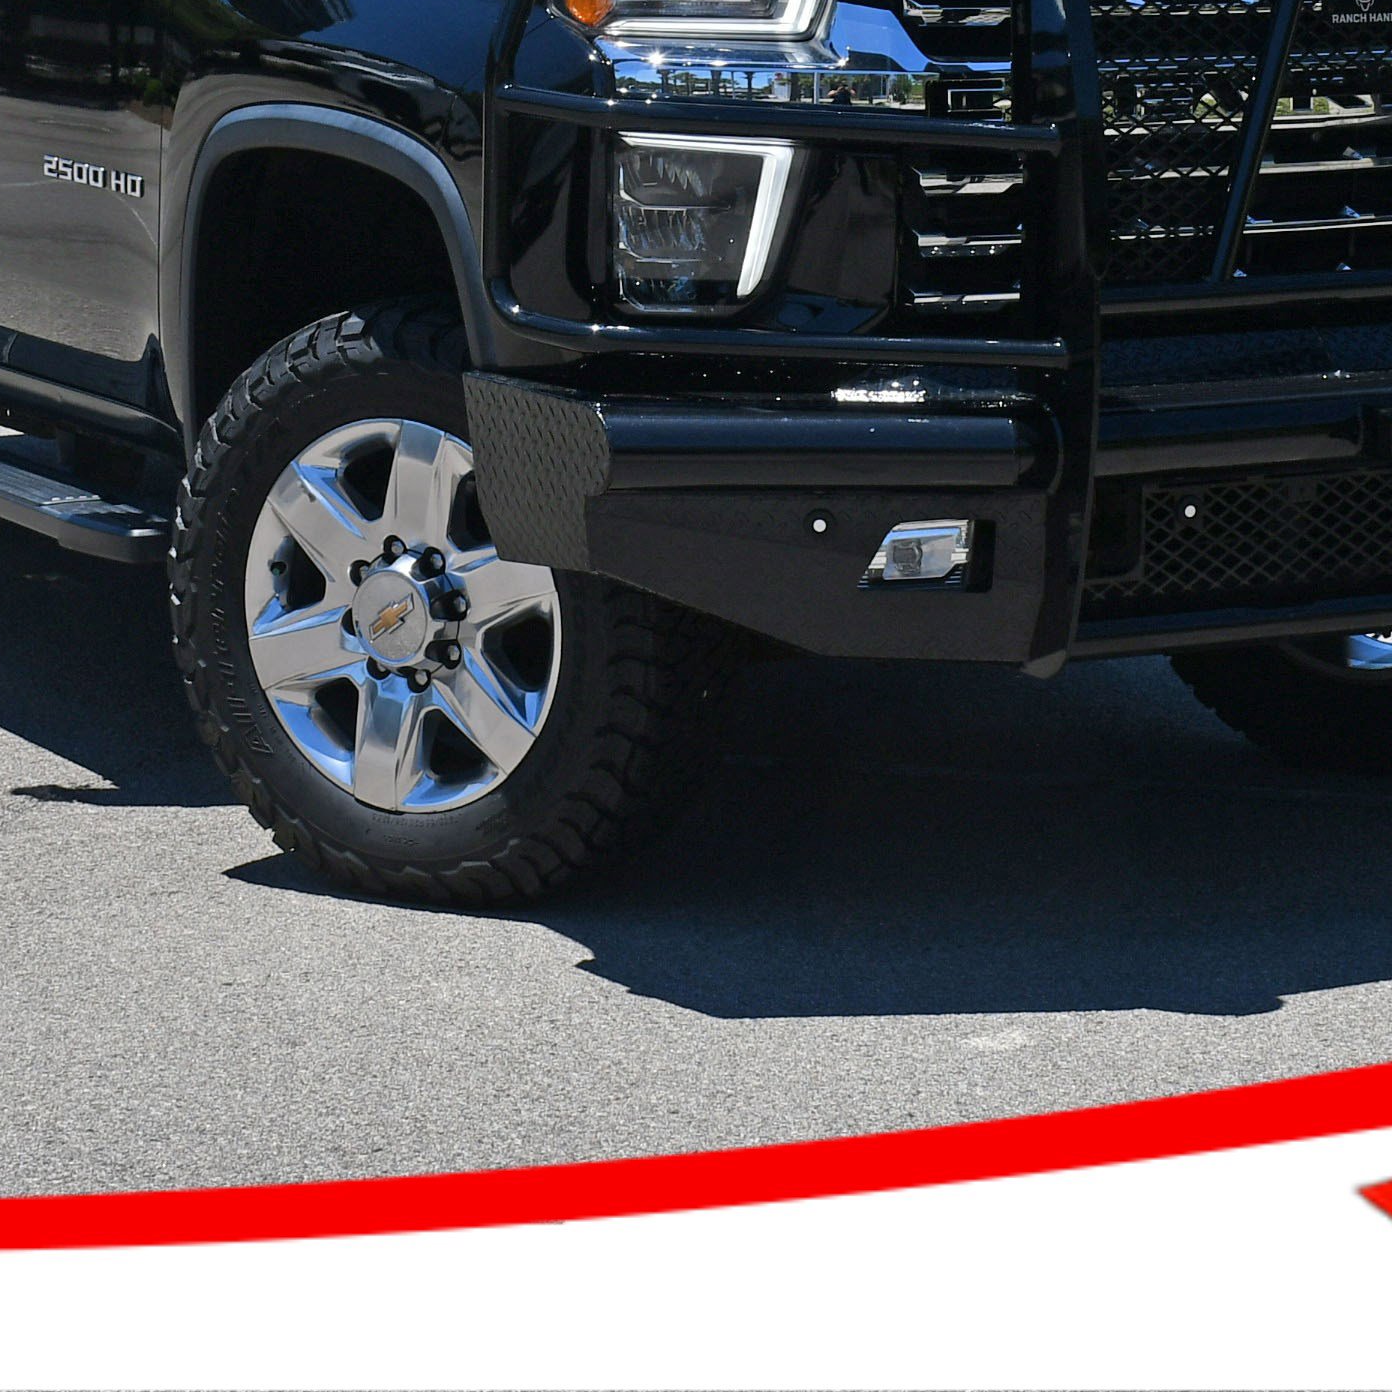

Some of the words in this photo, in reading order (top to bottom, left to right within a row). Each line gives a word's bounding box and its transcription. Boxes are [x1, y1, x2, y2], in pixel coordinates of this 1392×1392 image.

[1331, 13, 1367, 24] RANCH
[43, 154, 107, 188] 2500
[111, 170, 144, 198] HD
